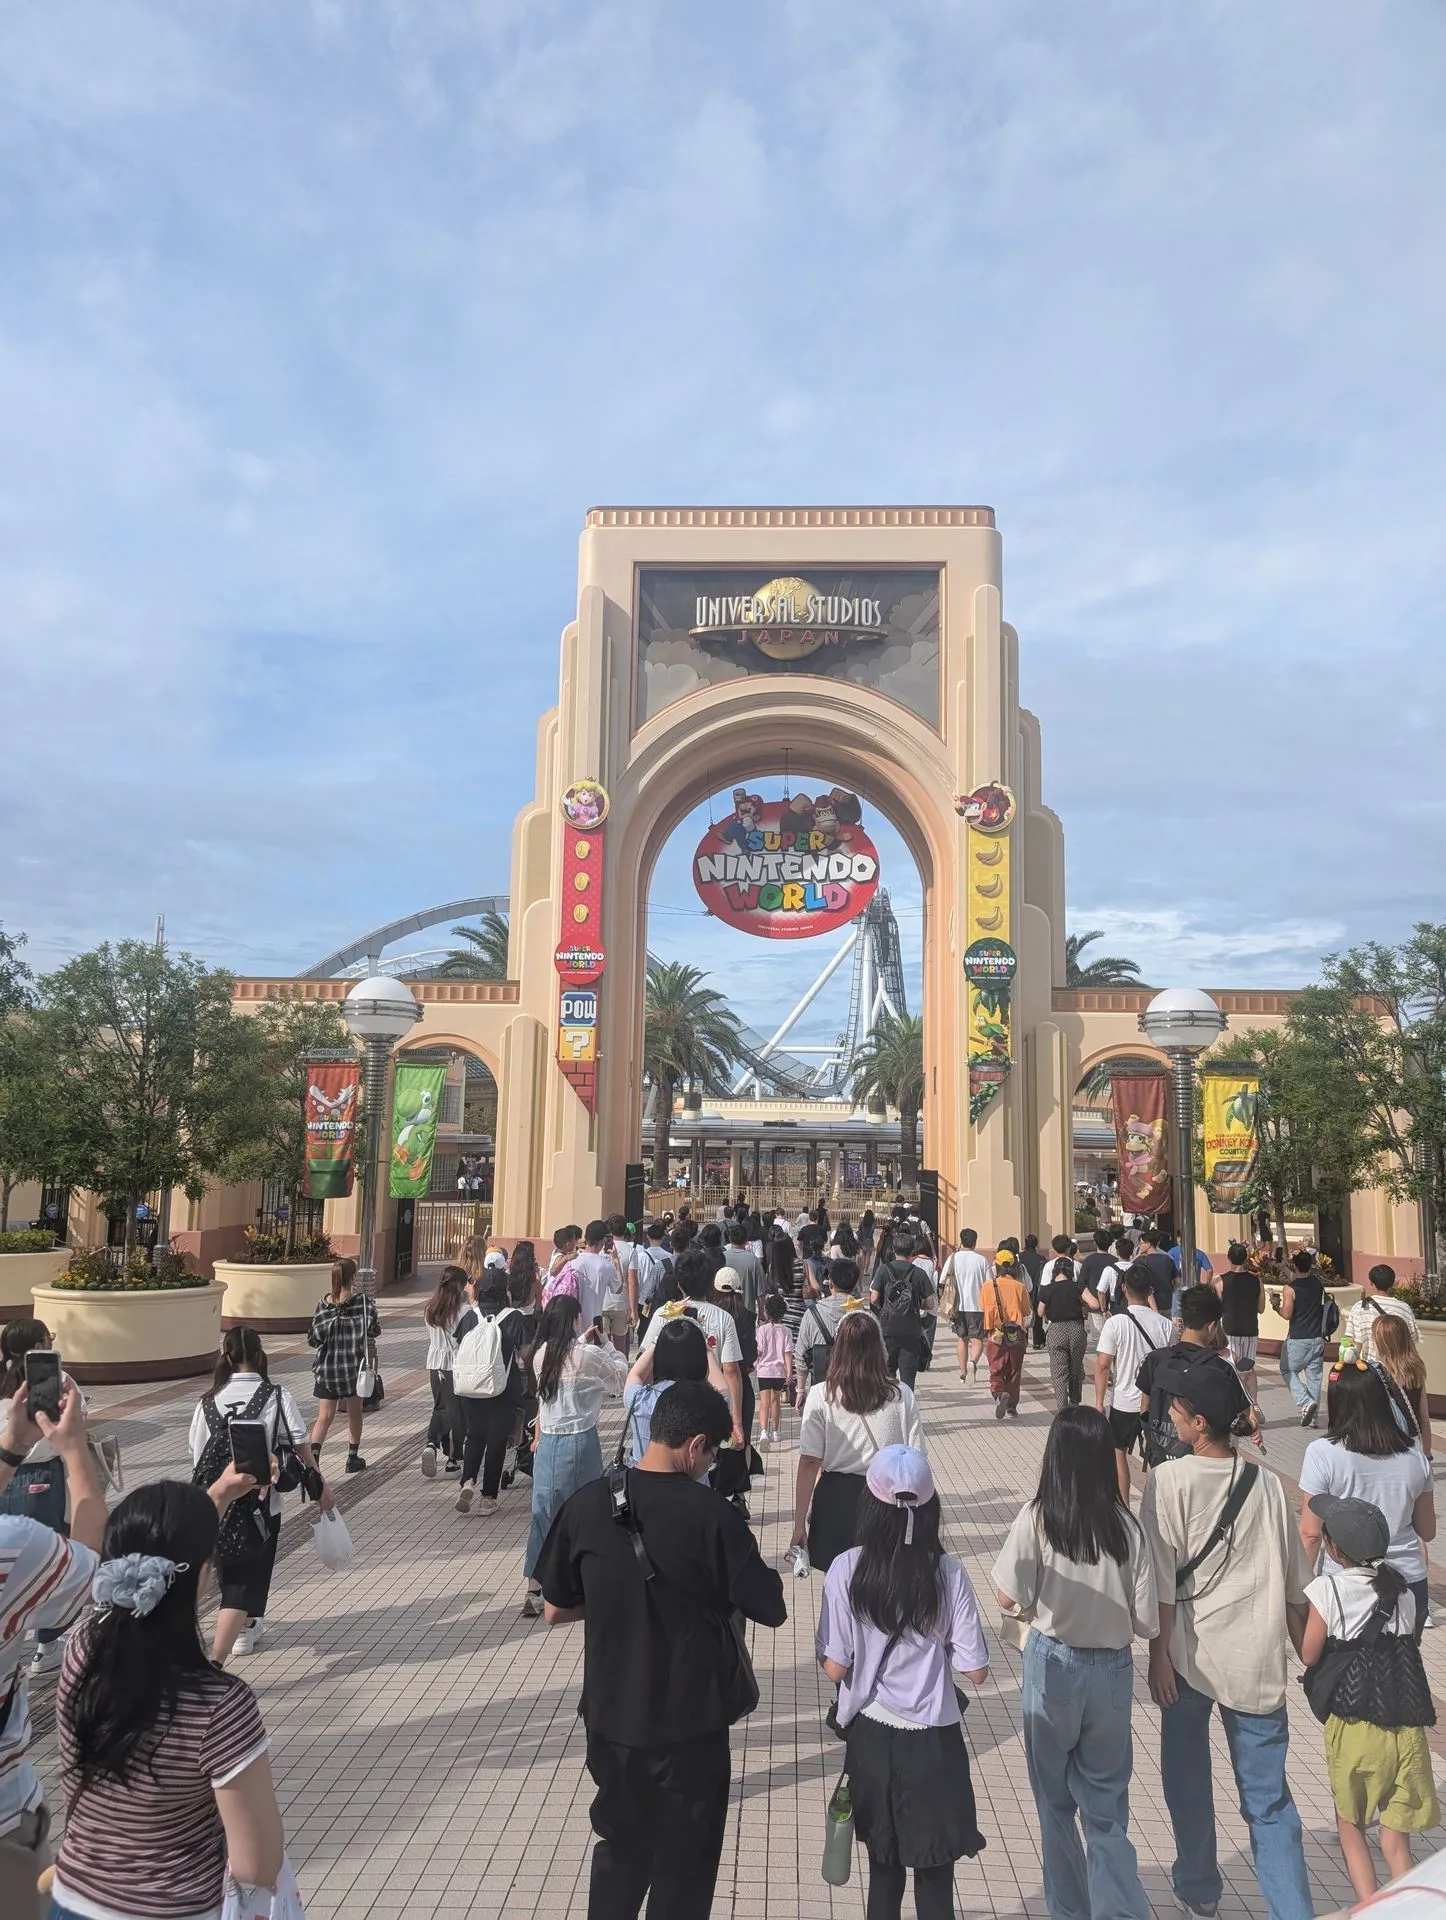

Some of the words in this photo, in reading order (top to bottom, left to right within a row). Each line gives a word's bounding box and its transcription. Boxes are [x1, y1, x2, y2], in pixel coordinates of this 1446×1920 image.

[696, 595, 800, 626] UNIVERSAL
[805, 594, 882, 627] STUDIOS
[737, 629, 840, 645] JAPAN
[747, 829, 826, 851] SUPER
[697, 853, 877, 883] NINTENDO
[724, 882, 849, 912] WORLD
[555, 952, 604, 960] NINTENDO
[965, 956, 1015, 965] NINTENDO
[972, 965, 1008, 974] WORLD
[561, 1000, 597, 1019] POW
[307, 1121, 354, 1130] NINTENDO
[1206, 1138, 1238, 1151] DONKEY
